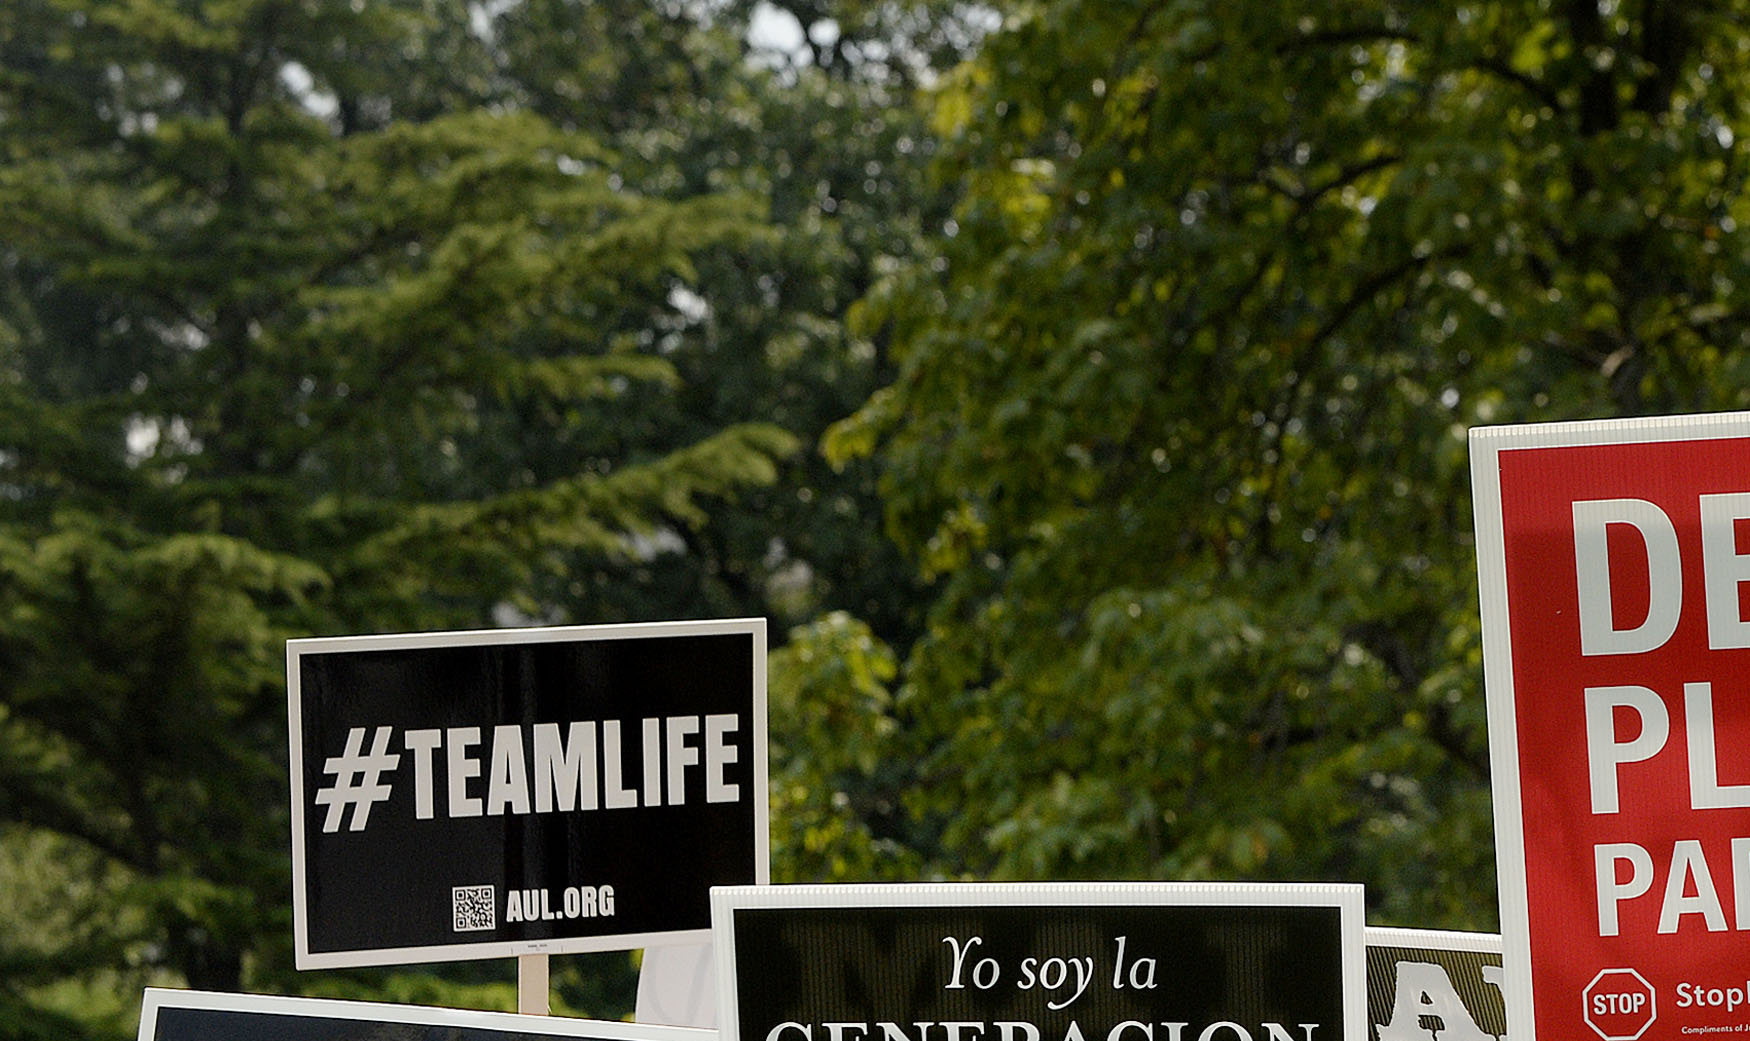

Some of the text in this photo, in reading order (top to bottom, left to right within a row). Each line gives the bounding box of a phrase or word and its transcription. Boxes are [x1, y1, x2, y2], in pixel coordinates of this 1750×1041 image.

[315, 713, 740, 833] #TEAMLIFE
[506, 884, 615, 922] AUL.ORG
[943, 936, 1158, 1010] Yo soy la
[1593, 992, 1646, 1015] STOP
[1681, 1025, 1733, 1036] Compliments
[1734, 1023, 1743, 1032] of
